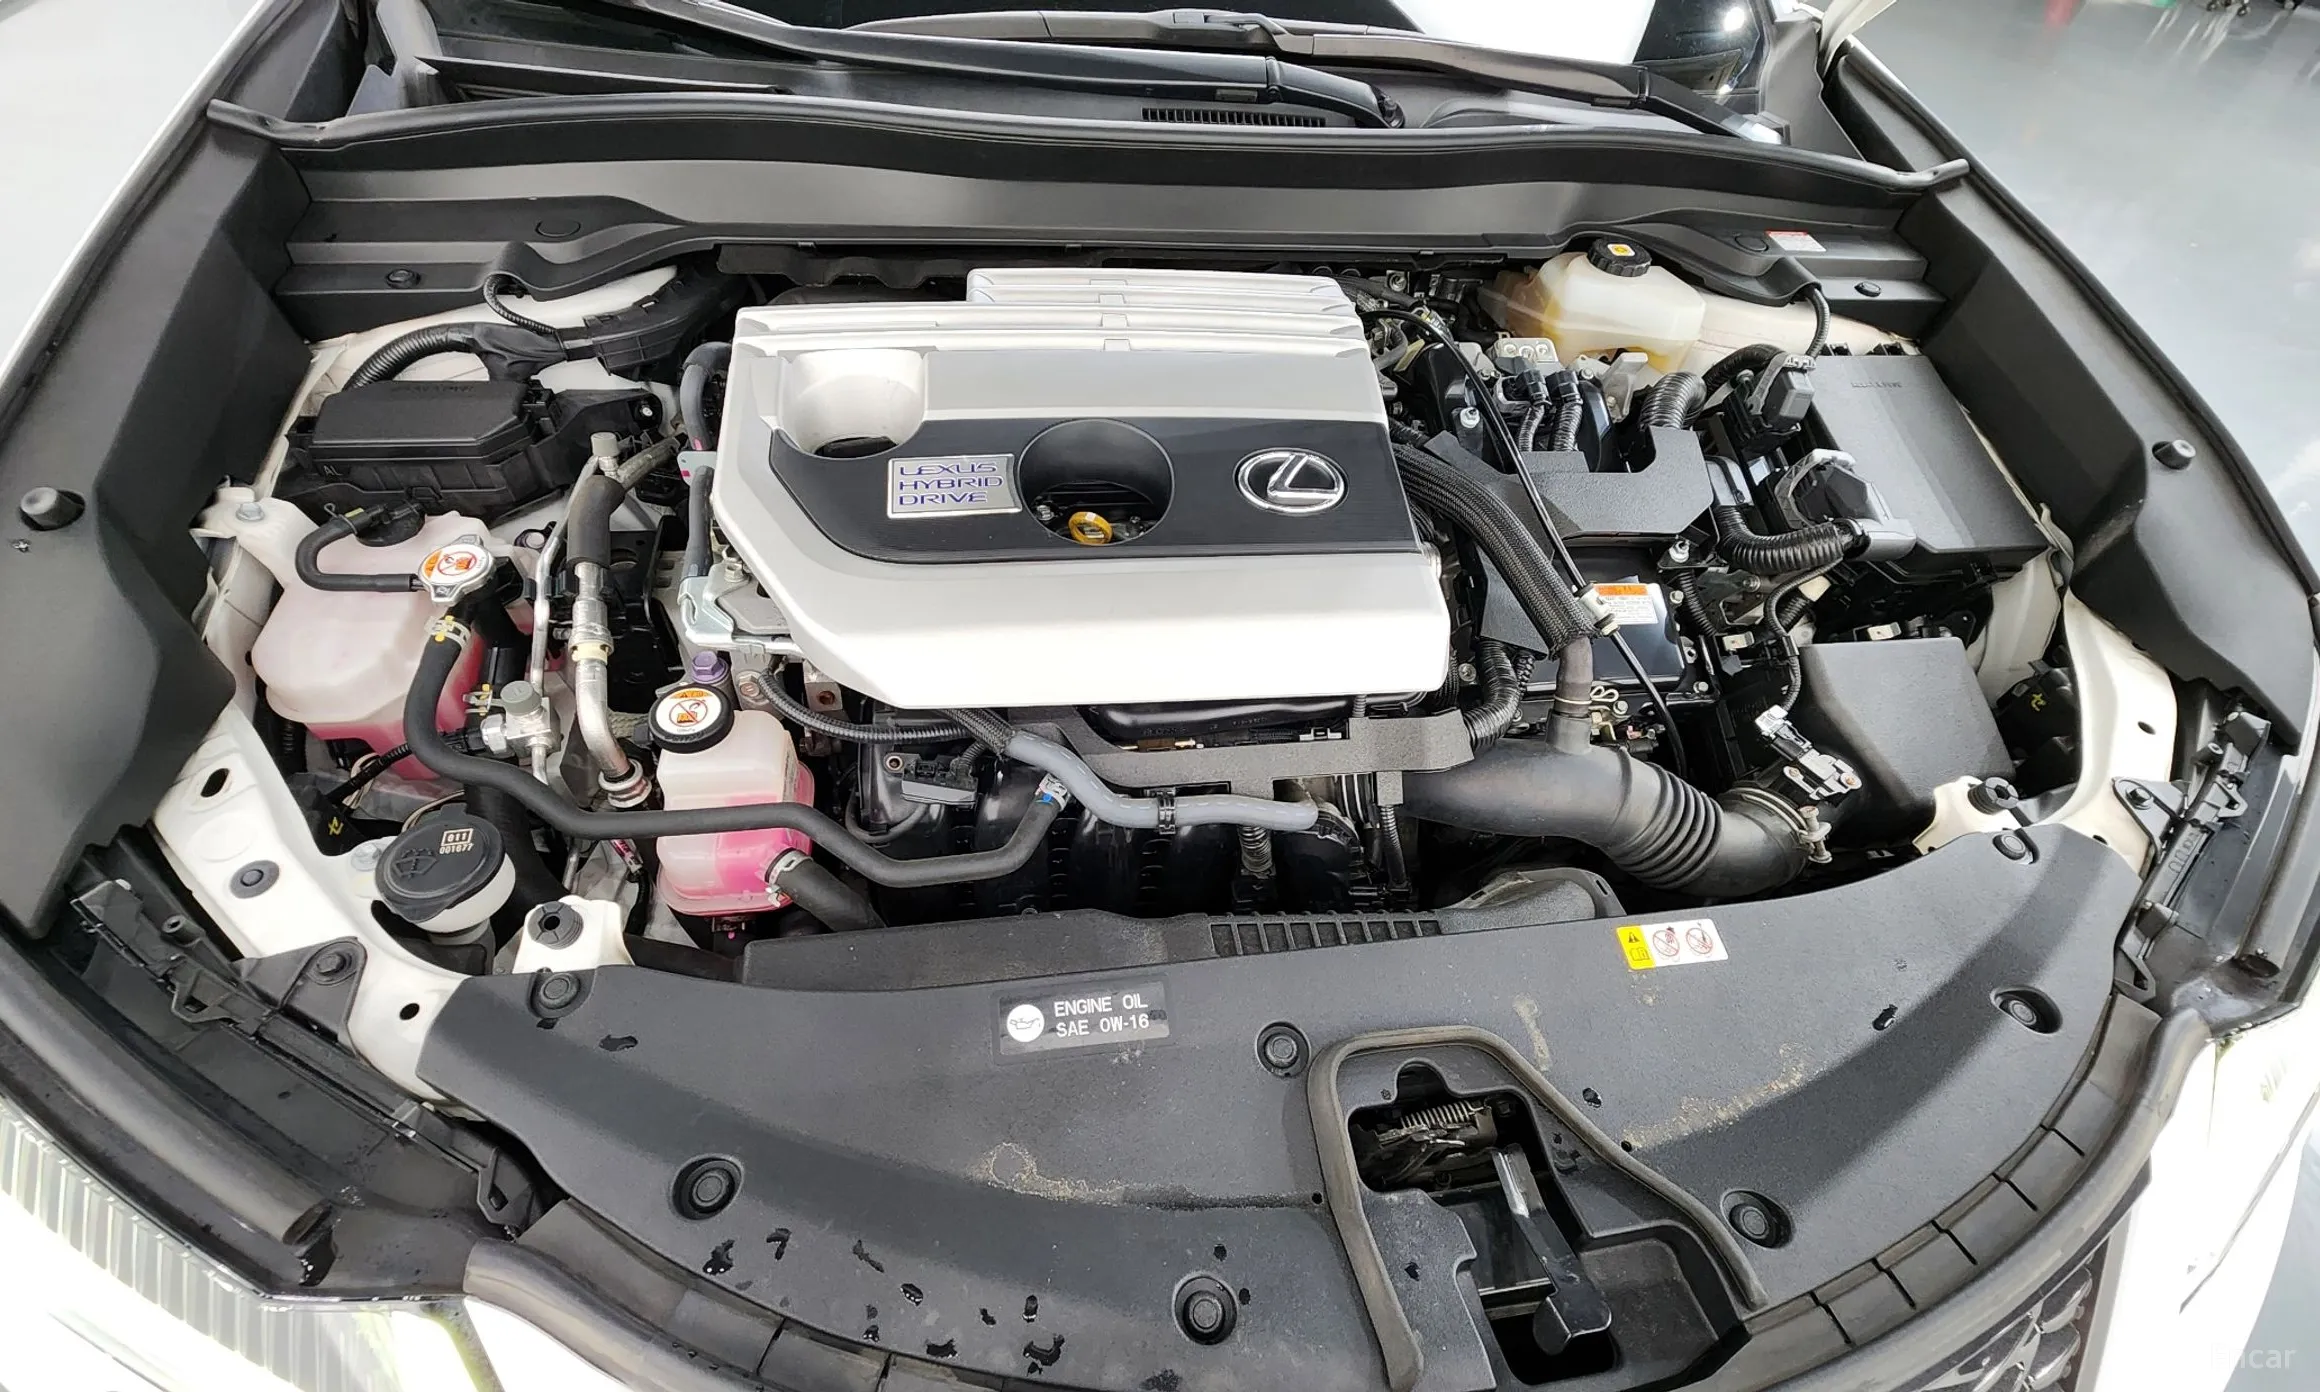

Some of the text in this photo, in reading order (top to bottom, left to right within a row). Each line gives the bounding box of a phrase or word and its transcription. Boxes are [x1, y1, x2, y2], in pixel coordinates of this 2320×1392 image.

[899, 462, 997, 476] LEXUS
[899, 476, 1003, 491] HYBRID
[899, 491, 988, 506] DRIVE
[1054, 992, 1149, 1018] ENGINE OIL
[1055, 1013, 1150, 1038] SAE 0W-16
